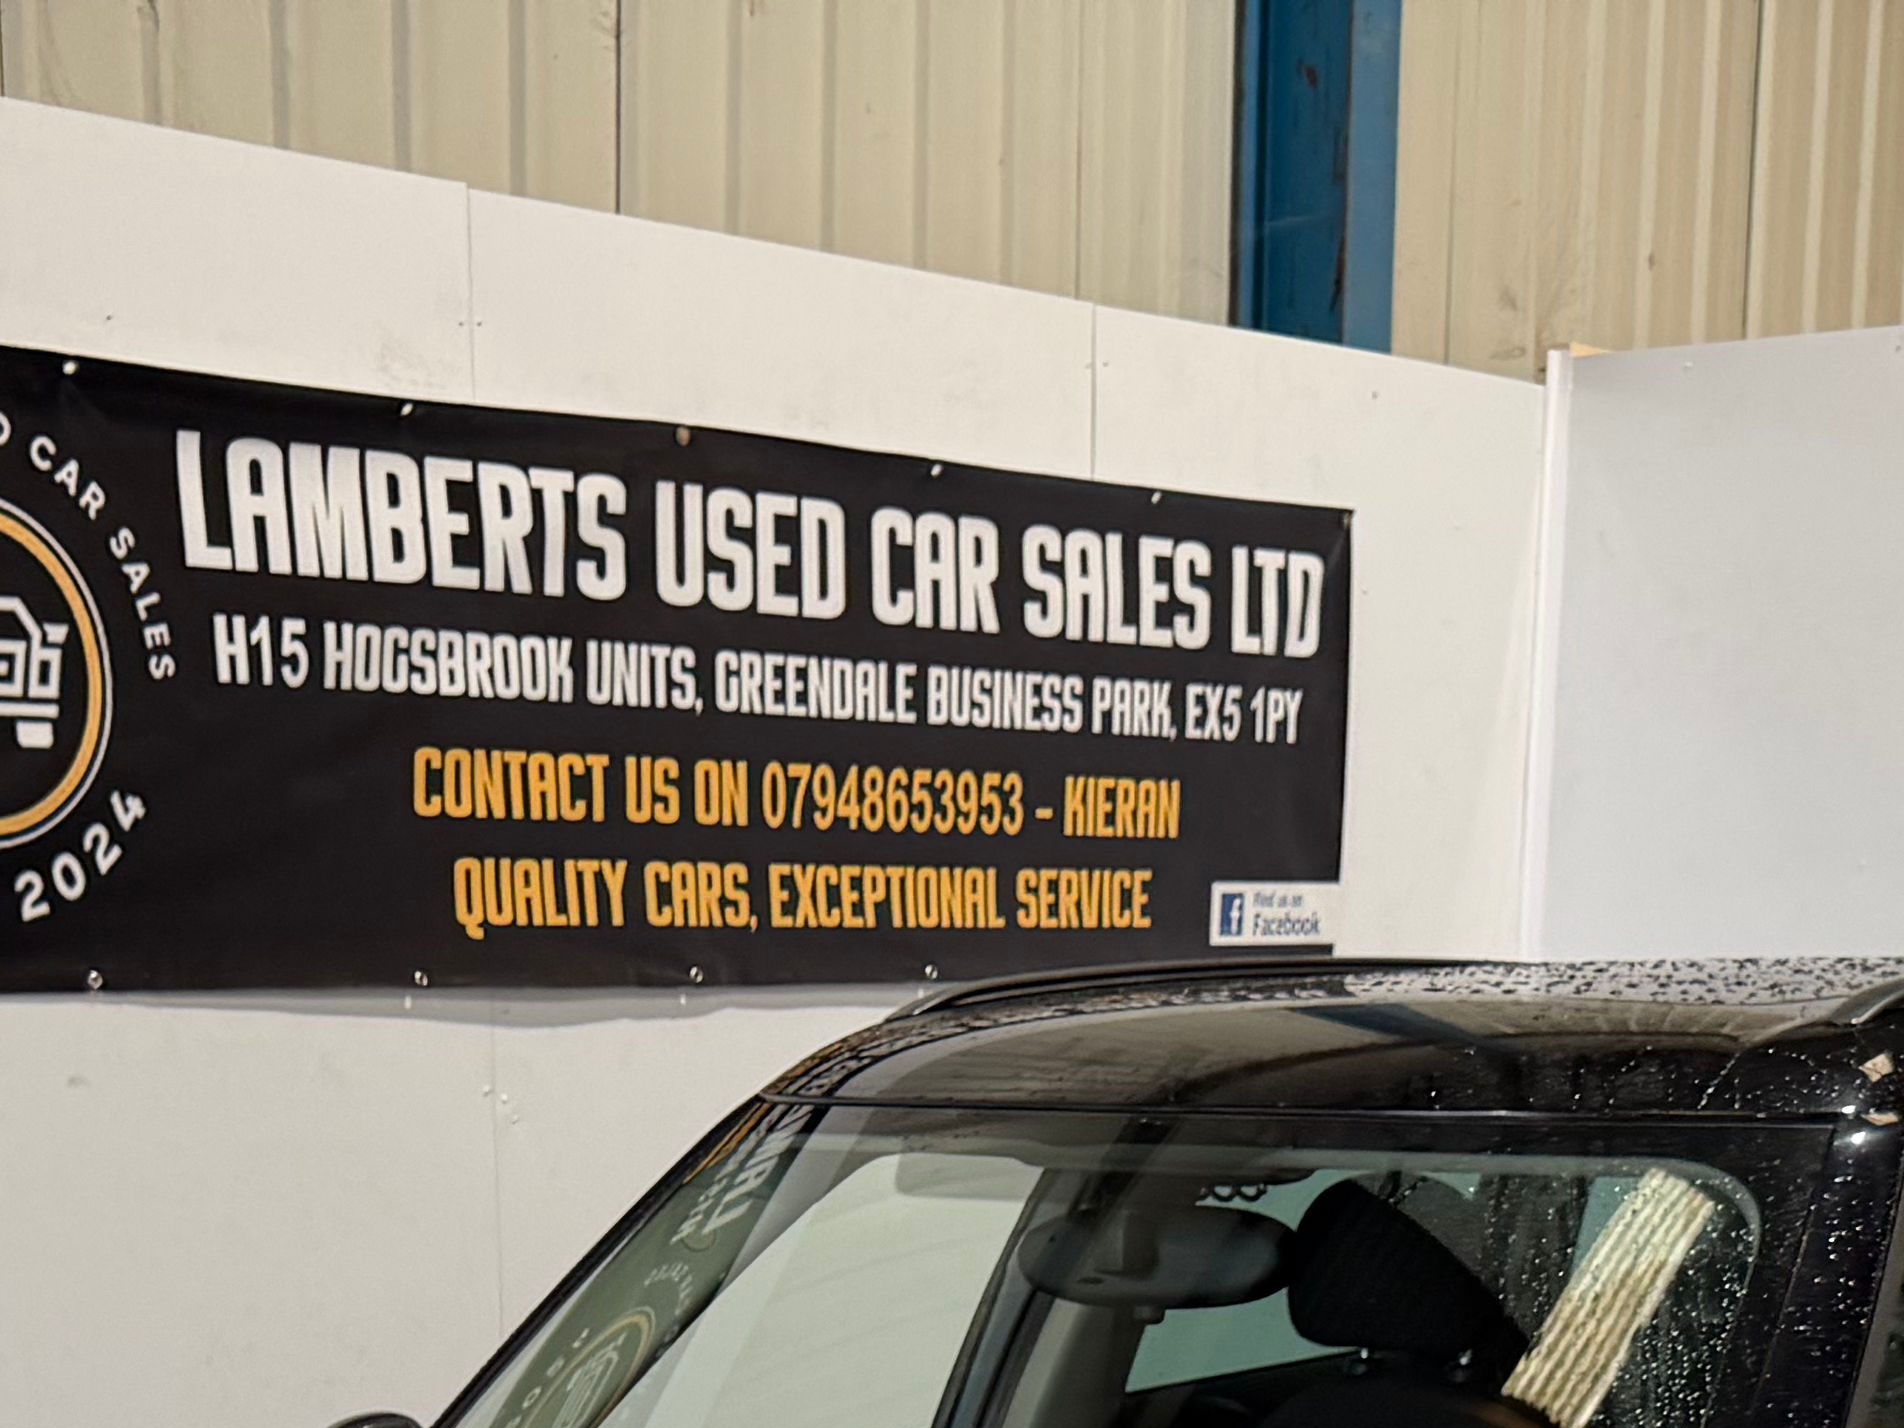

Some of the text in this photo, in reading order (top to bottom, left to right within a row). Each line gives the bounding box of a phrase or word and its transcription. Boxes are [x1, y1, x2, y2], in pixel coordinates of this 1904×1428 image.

[30, 436, 106, 520] CAR
[109, 527, 177, 681] SALES
[176, 429, 1325, 658] LAMBERTS USED CAR SALES LTD
[213, 613, 1303, 744] H15 HOGSBROOK UNITS, GREENDALE BUSINESS PARK, EX5 1PY
[14, 790, 147, 923] 2024
[413, 746, 610, 823] CONTACT
[625, 755, 680, 825] US
[694, 759, 749, 827] ON
[762, 760, 1025, 836] 07948653953
[1063, 775, 1181, 839] KIERAN
[453, 857, 1154, 941] QUALITY CARS, EXCEPTIONAL SERVICE
[1252, 912, 1322, 936] Facebook
